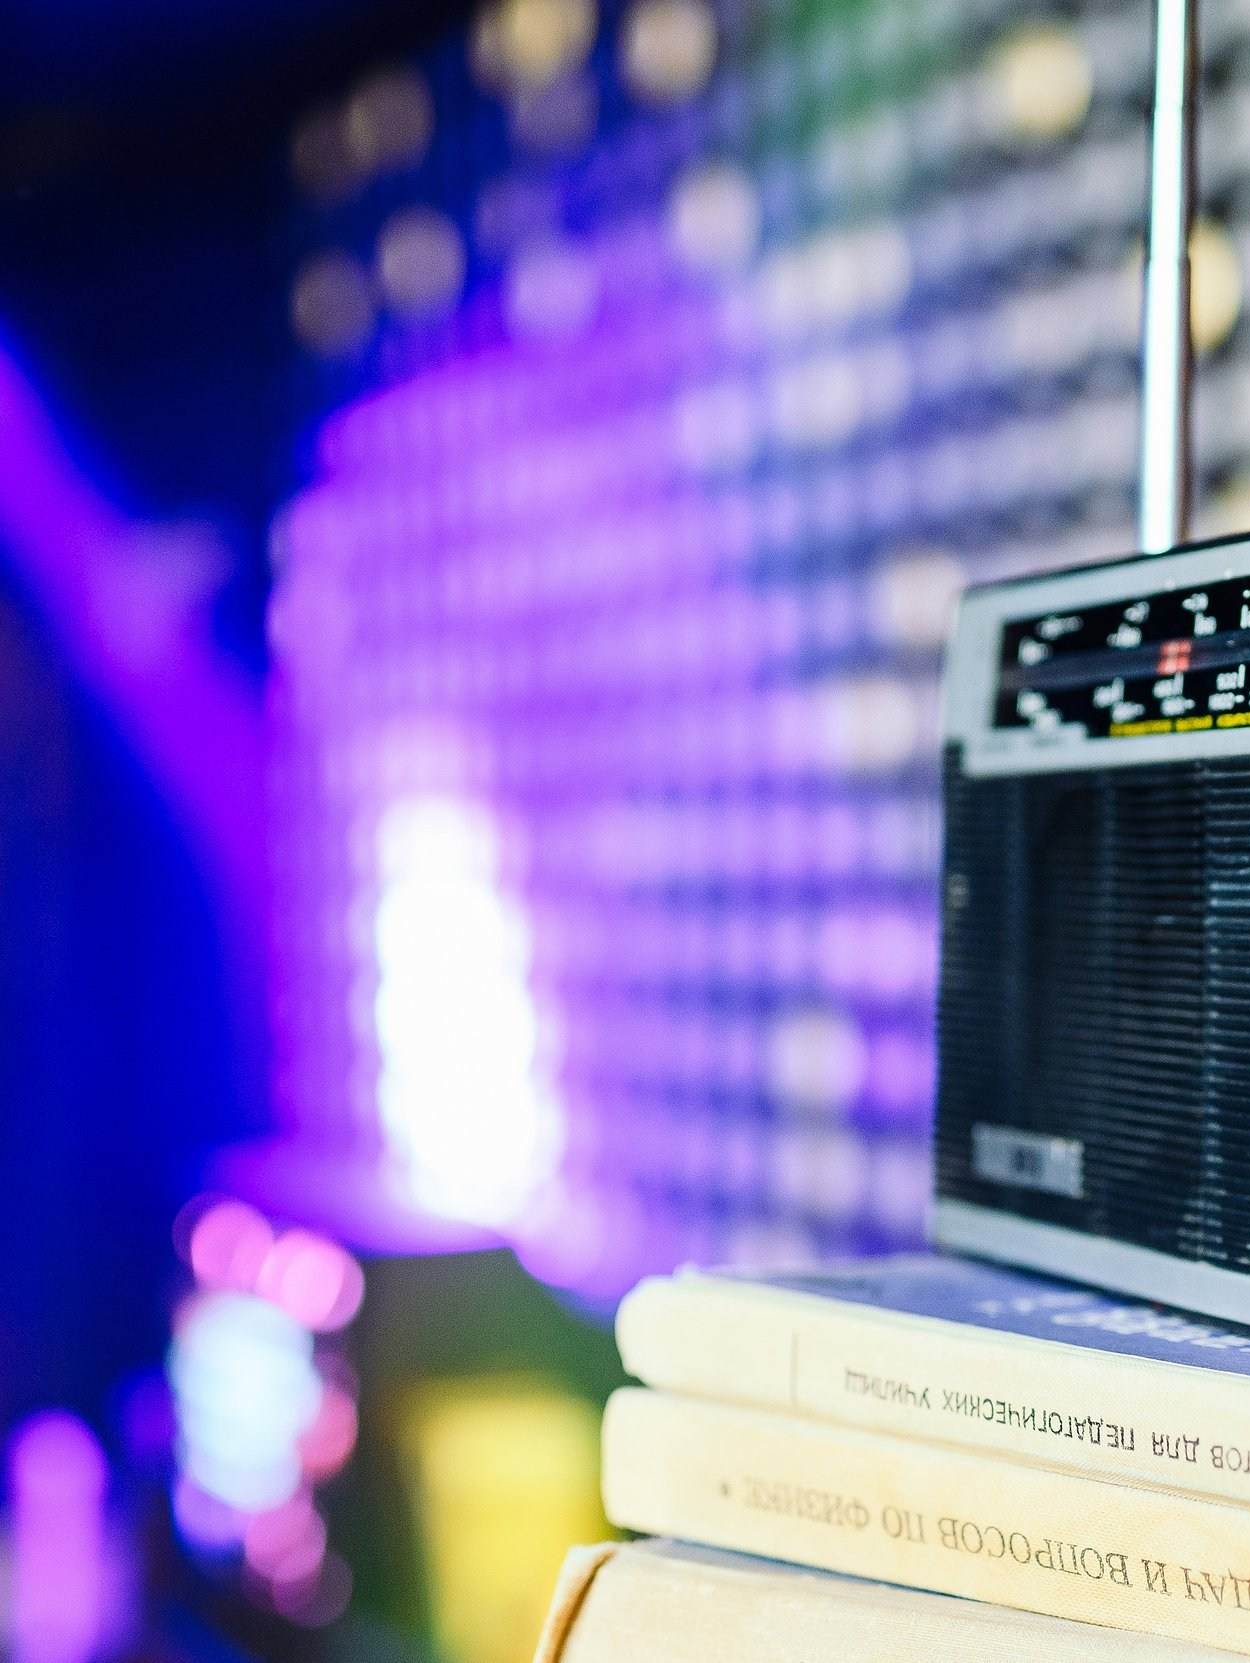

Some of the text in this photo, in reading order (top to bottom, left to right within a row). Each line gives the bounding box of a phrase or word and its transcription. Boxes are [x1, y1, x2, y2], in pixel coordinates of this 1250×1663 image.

[844, 1367, 932, 1411] УЧИЛИЩ
[942, 1390, 1136, 1452] ПЕДАГОГИЧЕСКИХ
[1151, 1431, 1201, 1464] ДЛЯ
[741, 1475, 871, 1531] ФИЗИКЕ
[882, 1505, 927, 1545] ПО
[937, 1517, 1135, 1588] ВОПРОСОВ
[1142, 1558, 1172, 1596] И
